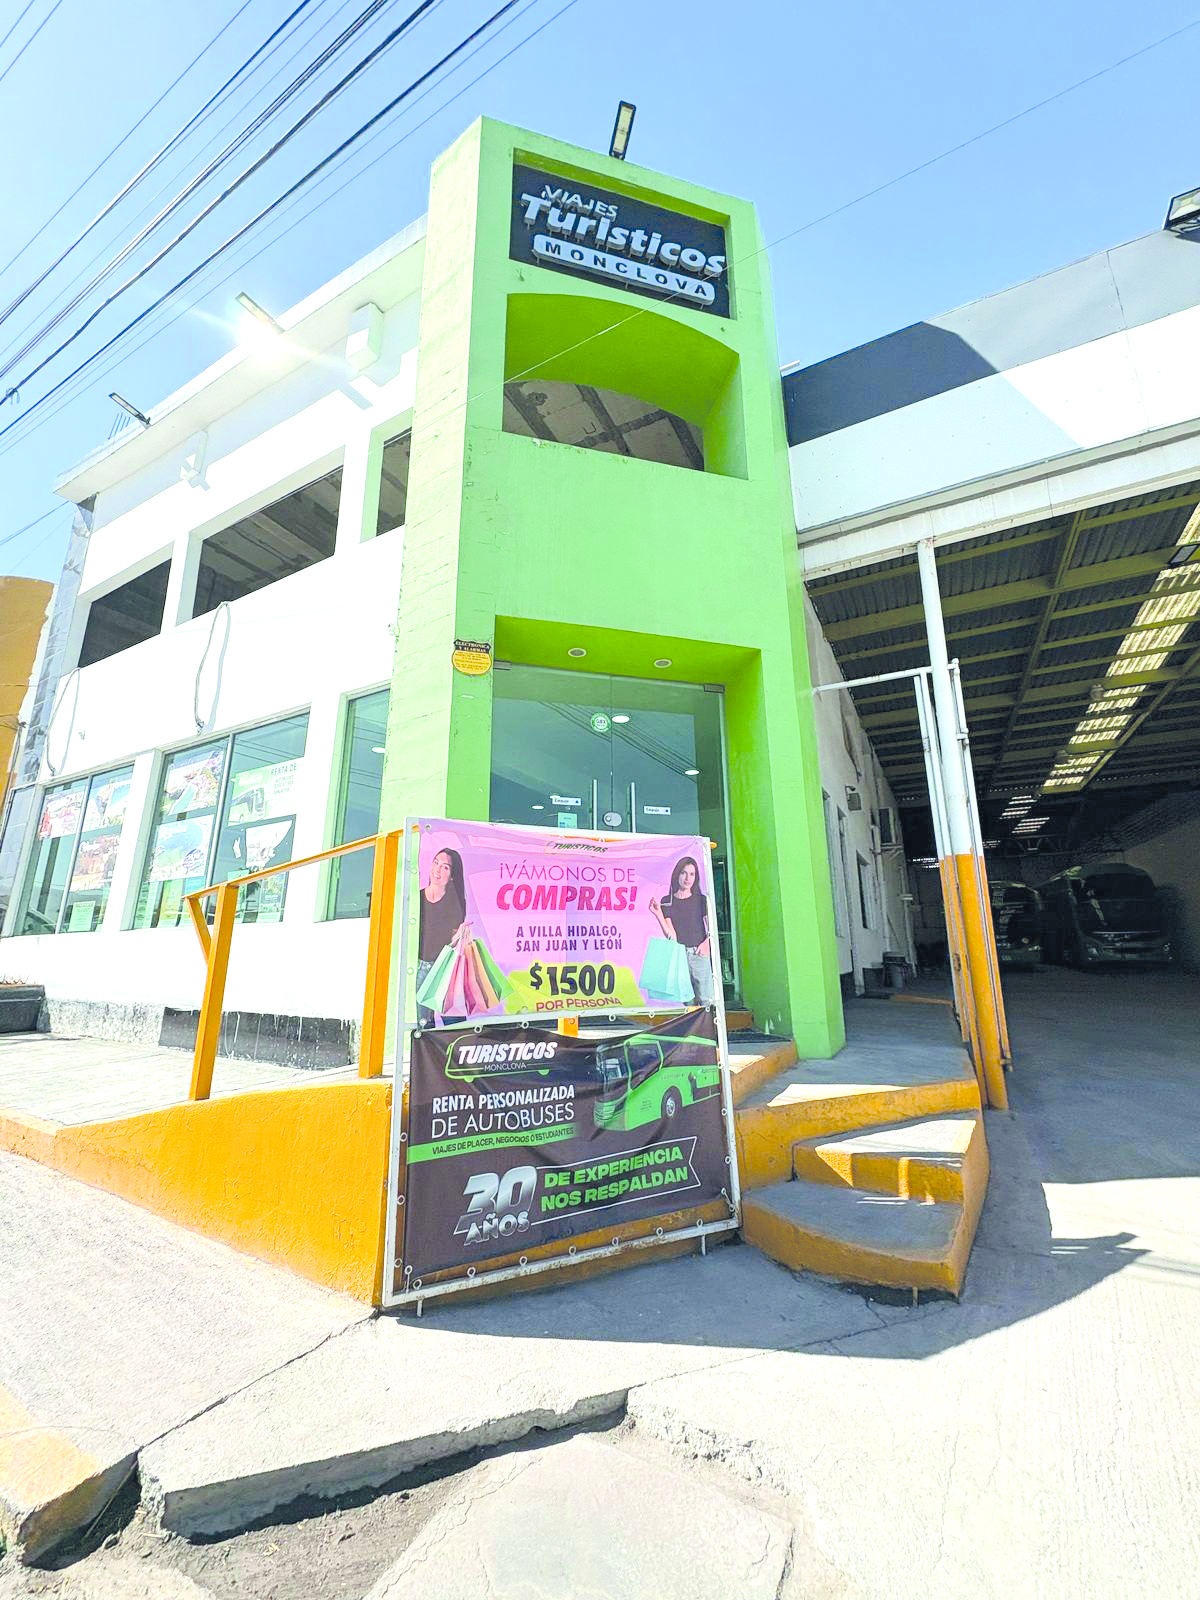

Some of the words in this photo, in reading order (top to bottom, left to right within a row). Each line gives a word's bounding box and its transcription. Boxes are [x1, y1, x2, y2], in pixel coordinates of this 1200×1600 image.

[542, 184, 619, 219] VIAJES
[520, 193, 726, 277] Turisticos
[544, 241, 707, 297] MONCLOVA
[500, 859, 607, 882] ¡VÁMONOS
[613, 868, 636, 882] DE
[496, 883, 638, 911] COMPRAS!
[516, 926, 524, 937] A
[529, 926, 563, 937] VILLA
[567, 925, 622, 938] HIDALGO,
[516, 940, 540, 952] SAN
[545, 939, 577, 951] JUAN
[582, 939, 589, 950] Y
[594, 936, 622, 950] LEÓN
[530, 962, 615, 996] $1500
[536, 1000, 564, 1012] POR
[566, 996, 623, 1008] PERSONA
[458, 1042, 558, 1064] TURISTICOS
[484, 1062, 527, 1071] MONCLOVA
[432, 1095, 475, 1114] RENTA
[478, 1084, 575, 1110] PERSONALIZADA
[431, 1116, 458, 1138] DE
[464, 1102, 575, 1133] AUTOBUSES
[432, 1143, 456, 1155] VIAJES
[457, 1142, 467, 1151] DE
[466, 1138, 495, 1148] PLACER,
[495, 1136, 530, 1145] NEGOCIOS
[535, 1127, 574, 1141] ESTUDIANTES
[544, 1172, 570, 1188] DE
[573, 1147, 684, 1184] EXPERIENCIA
[454, 1166, 537, 1233] 30
[541, 1191, 582, 1212] NOS
[584, 1166, 688, 1203] RESPALDAN
[463, 1211, 529, 1247] AÑOS
